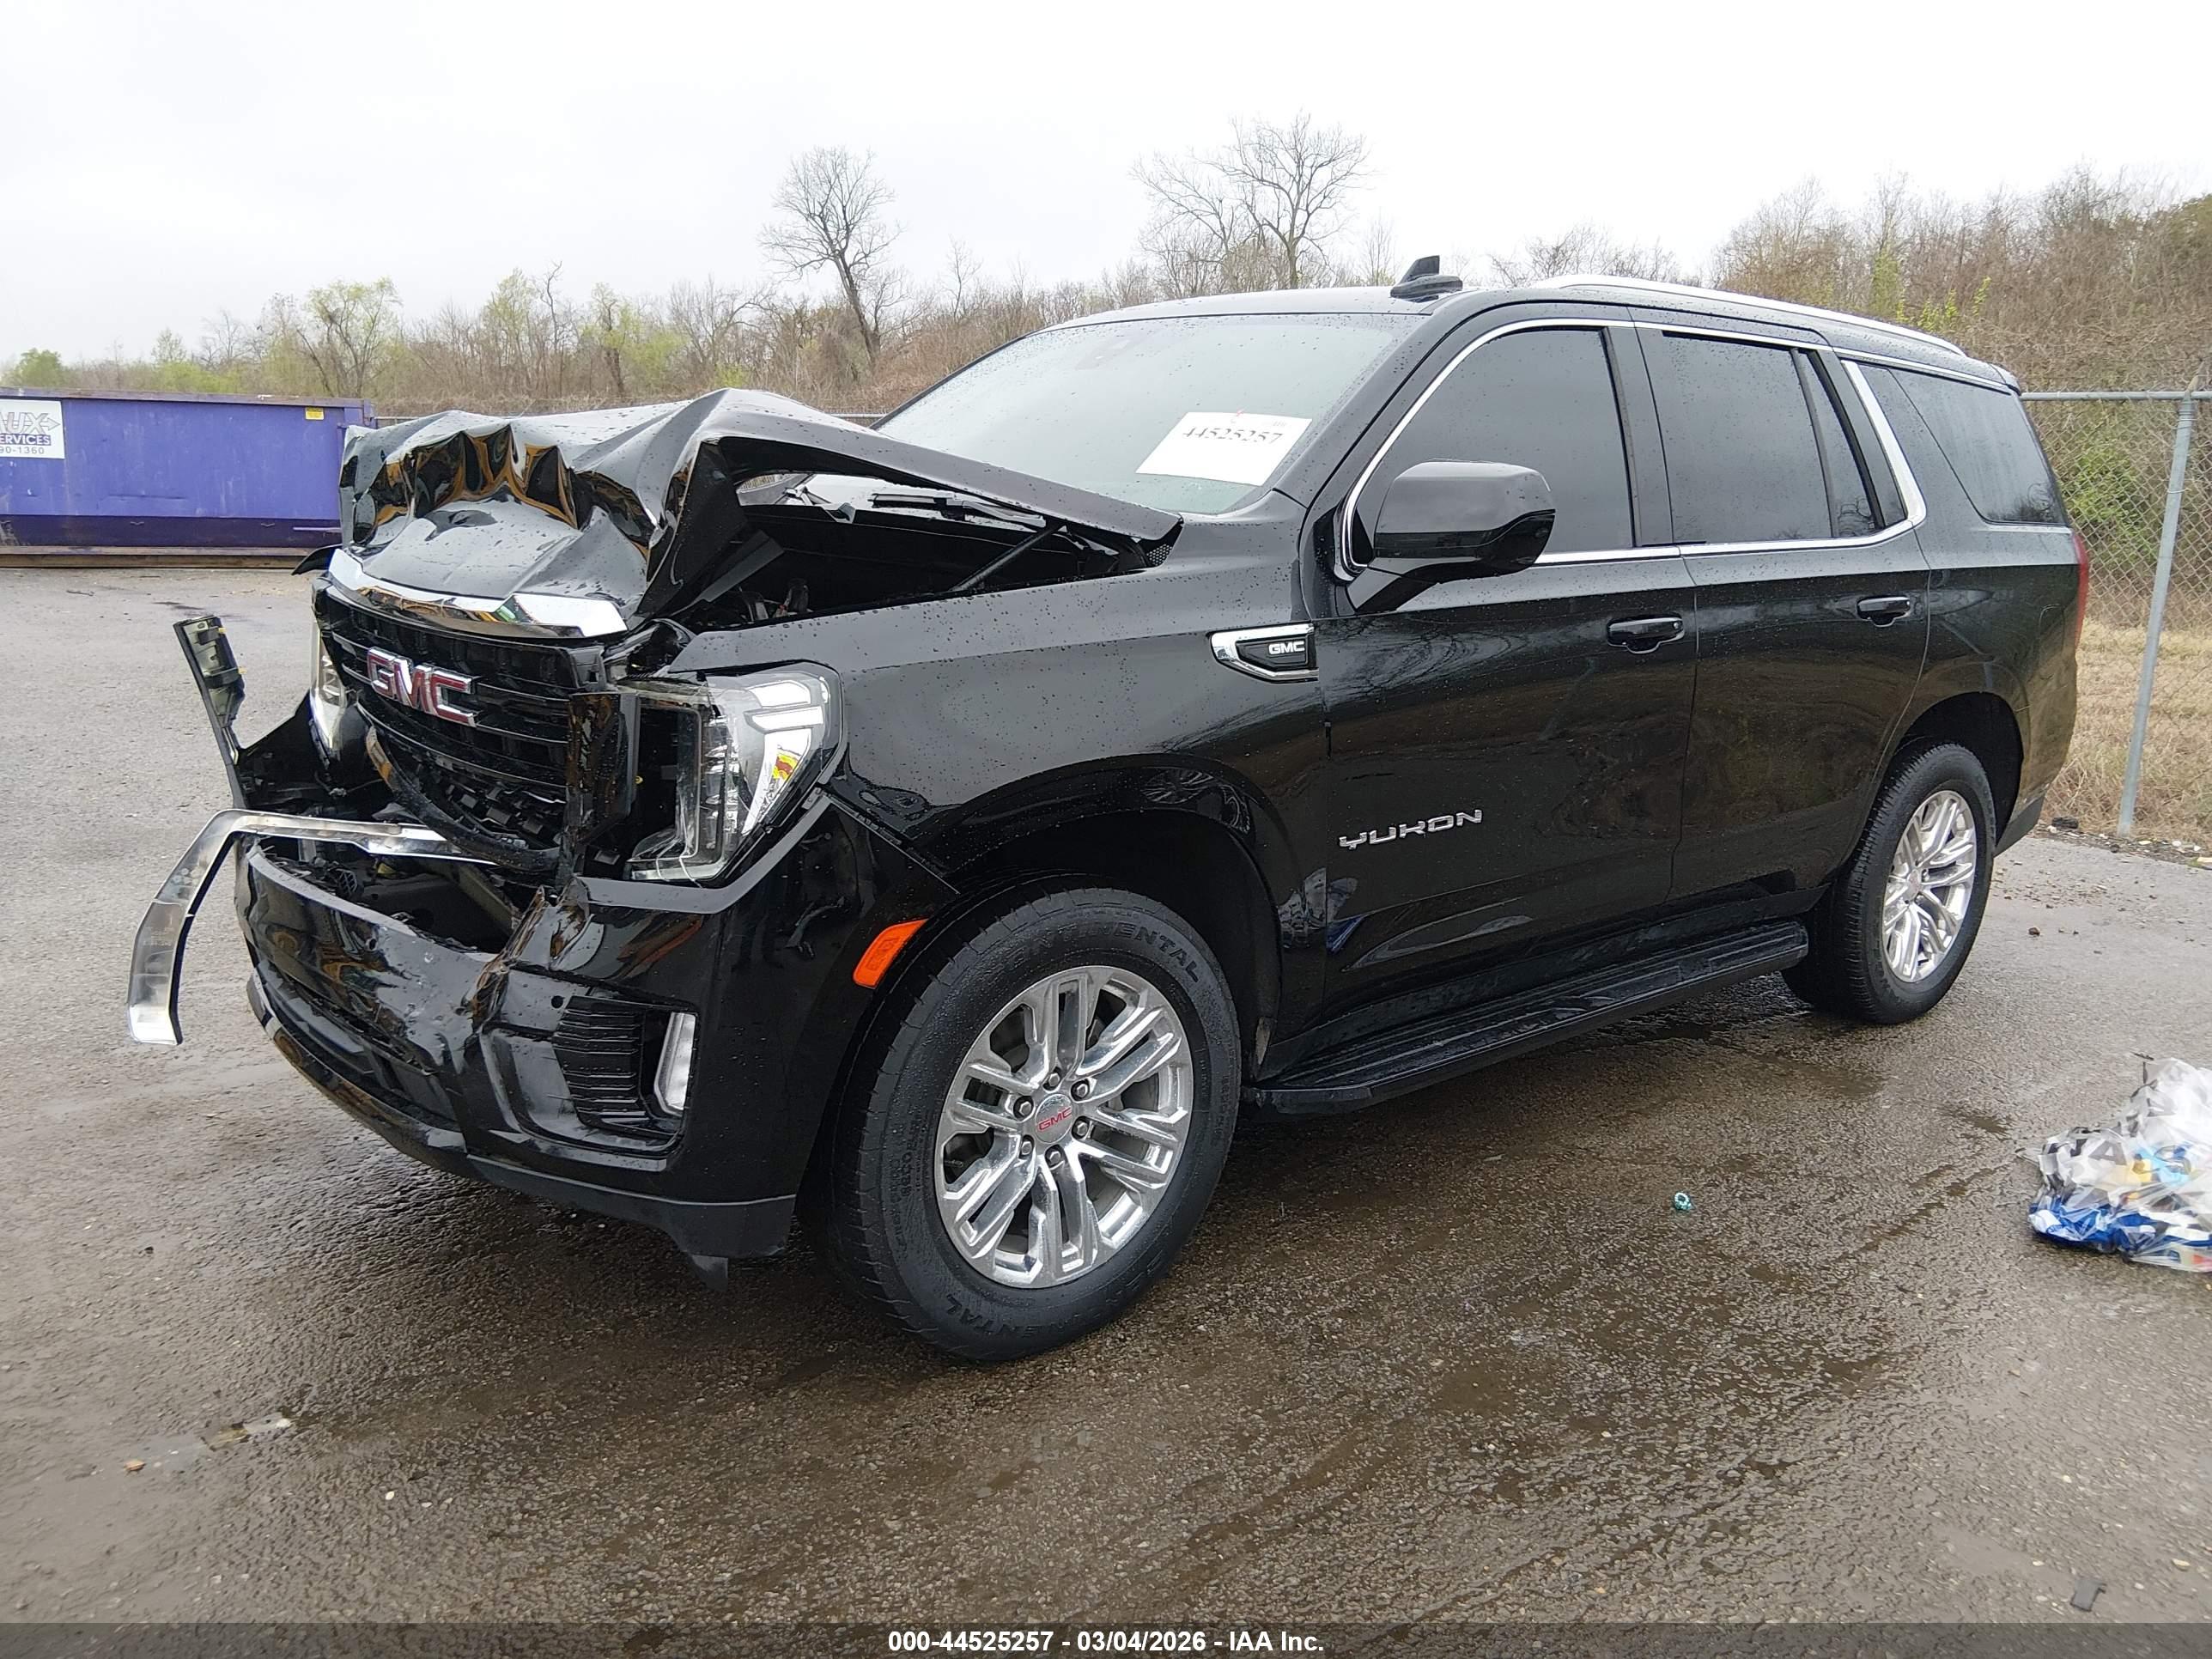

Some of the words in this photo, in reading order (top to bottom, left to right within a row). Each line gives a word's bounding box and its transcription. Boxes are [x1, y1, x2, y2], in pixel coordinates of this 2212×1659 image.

[1182, 426, 1285, 444] 44525257
[1268, 641, 1305, 655] GMC
[367, 647, 477, 727] GMC
[1339, 809, 1483, 850] YUKON
[1037, 1106, 1073, 1133] GMC
